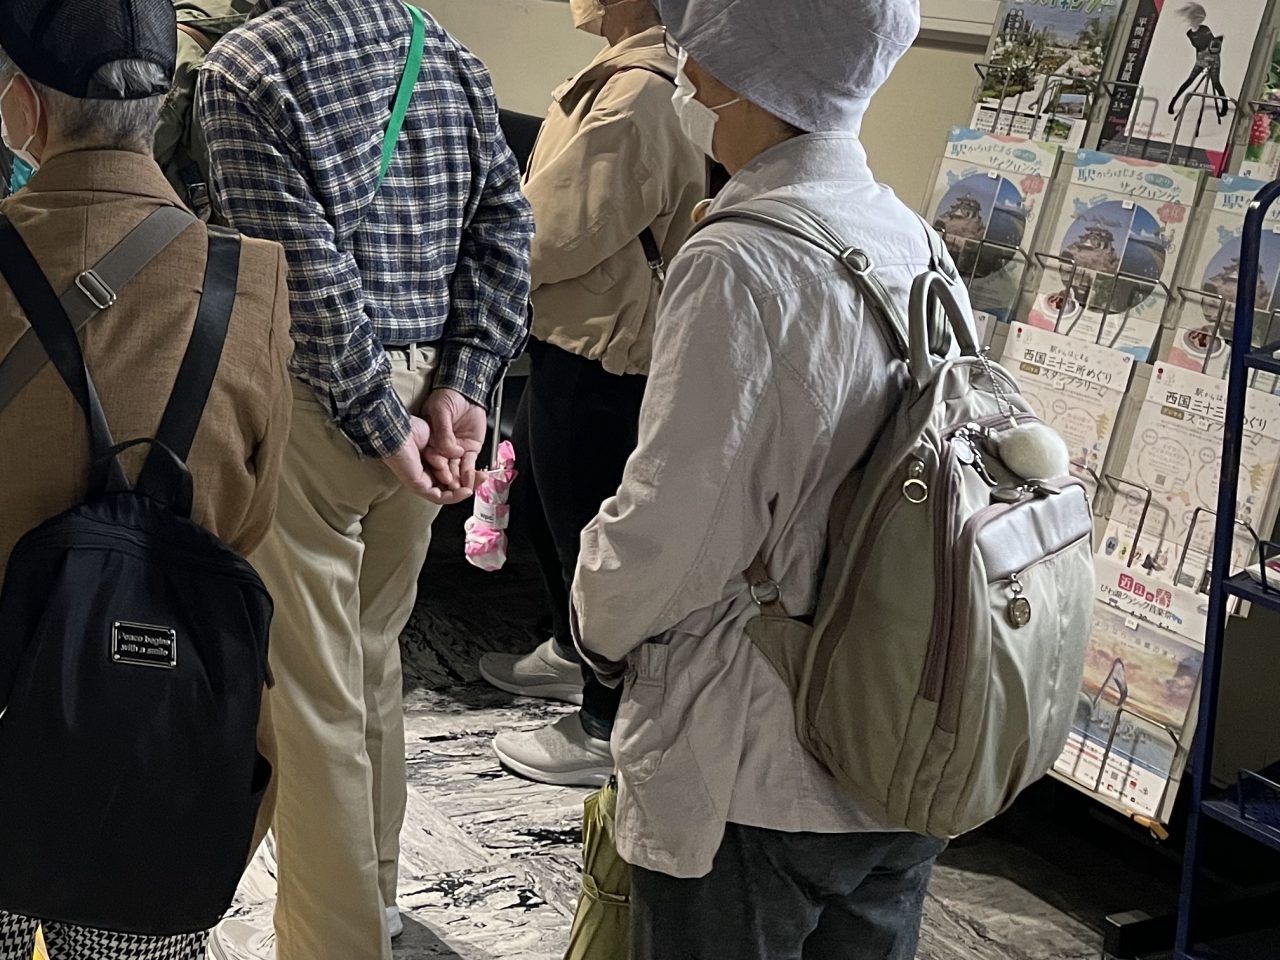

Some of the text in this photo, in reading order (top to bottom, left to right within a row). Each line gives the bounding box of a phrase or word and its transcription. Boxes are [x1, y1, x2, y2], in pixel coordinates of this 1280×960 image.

[1077, 168, 1144, 182] 駅からはじまる
[1024, 348, 1112, 384] 西国三十三所めぐり
[1195, 387, 1226, 404] 駅からは
[1118, 573, 1172, 608] 近江の春
[144, 635, 171, 646] begins
[120, 644, 138, 652] with
[147, 647, 169, 656] smile
